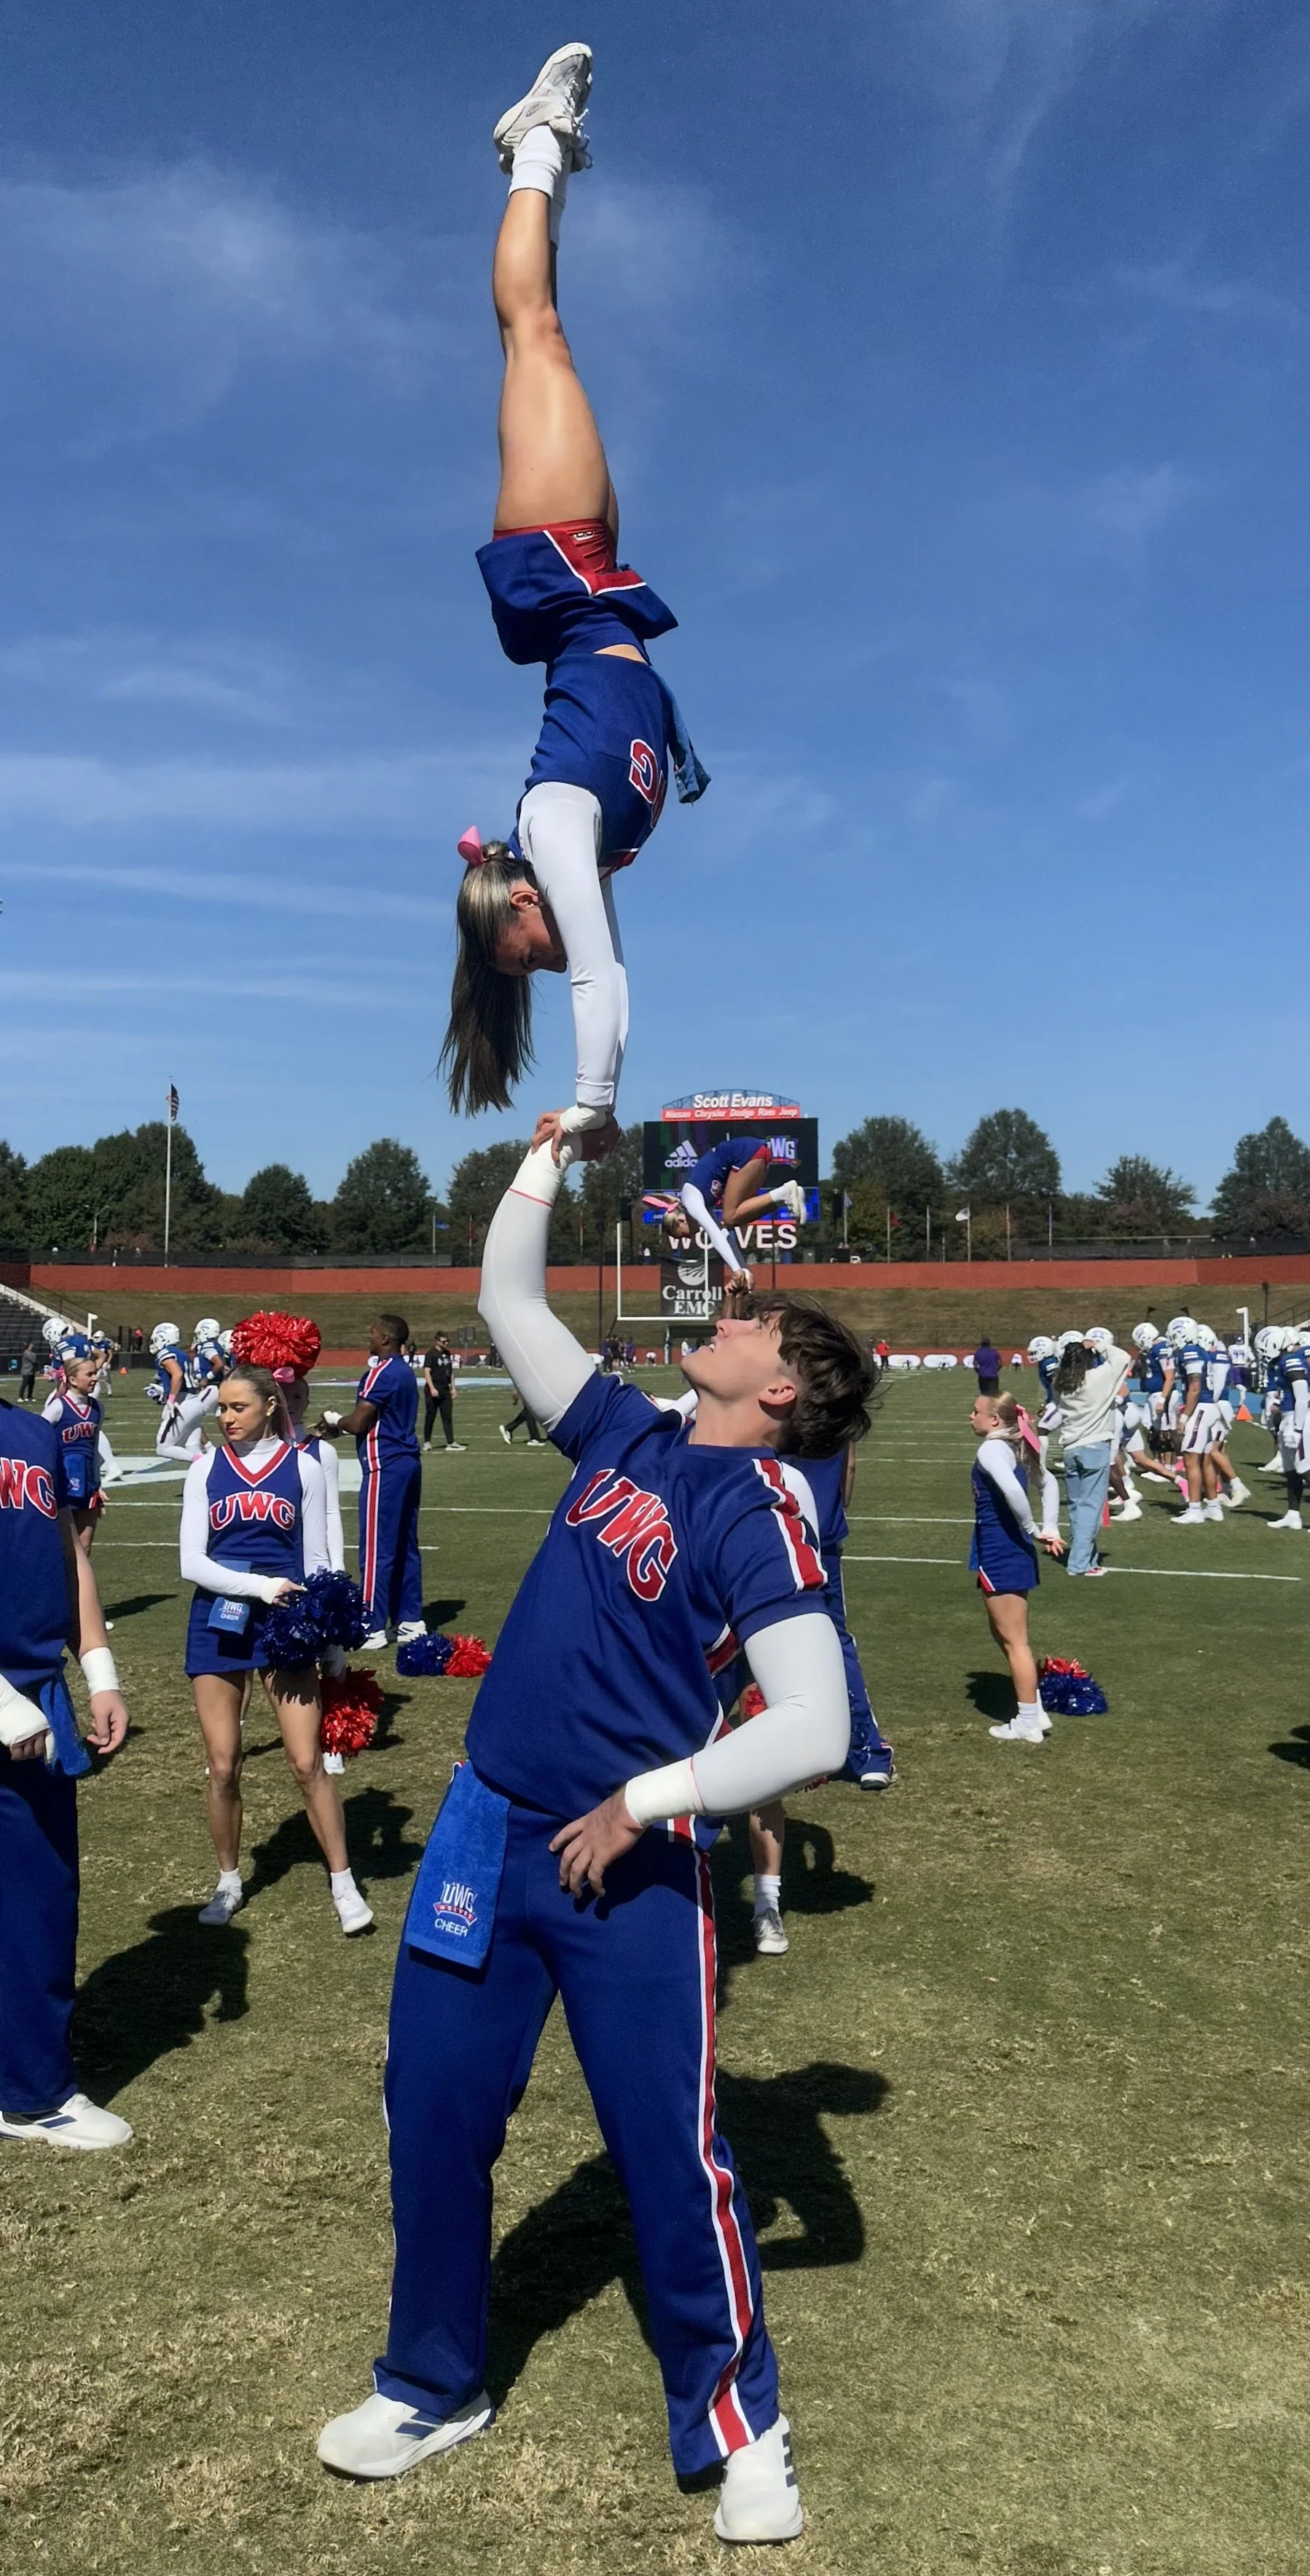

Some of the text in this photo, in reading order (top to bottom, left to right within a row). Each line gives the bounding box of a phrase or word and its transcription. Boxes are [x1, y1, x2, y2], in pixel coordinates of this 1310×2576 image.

[694, 1093, 773, 1109] Scott Evans
[694, 1110, 726, 1120] Chrysler
[729, 1108, 754, 1118] Dodge
[758, 1107, 776, 1117] Ram
[779, 1107, 798, 1118] Jeep
[767, 1137, 796, 1159] WG
[664, 1157, 698, 1168] adida
[668, 1224, 797, 1249] WOVES
[662, 1285, 722, 1300] Carroll
[674, 1300, 715, 1315] EMC
[1233, 1349, 1245, 1359] 44
[62, 1421, 97, 1442] UW
[210, 1491, 295, 1531] UWG
[565, 1469, 678, 1601] UWG
[224, 1600, 243, 1612] UWG
[443, 1882, 475, 1914] UWG
[434, 1917, 468, 1938] CHEER
